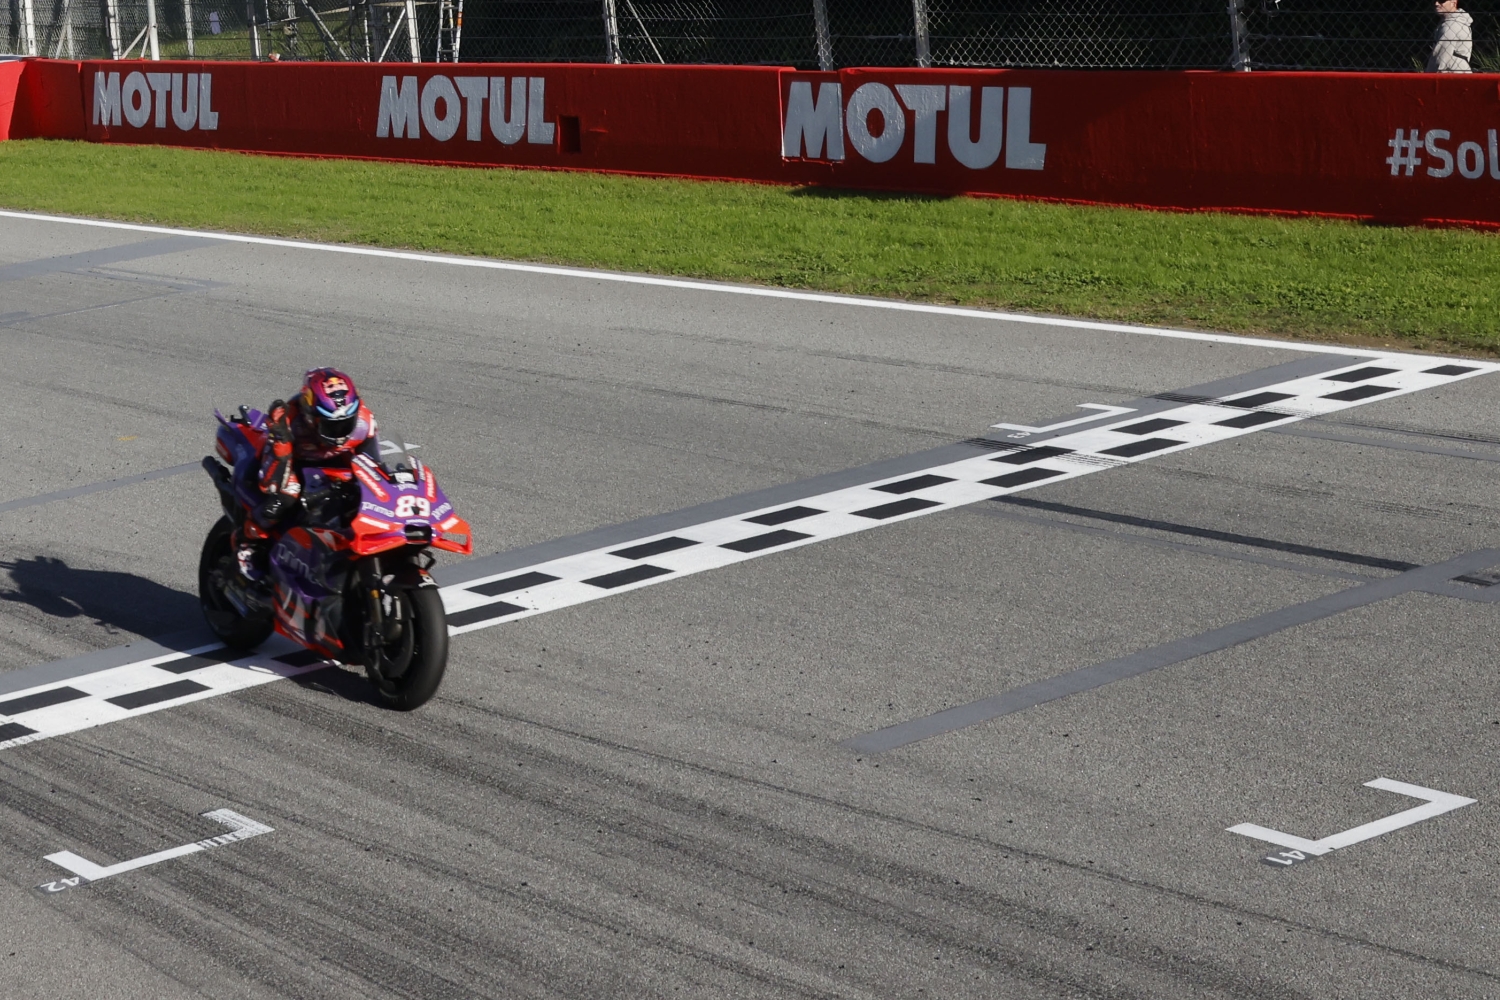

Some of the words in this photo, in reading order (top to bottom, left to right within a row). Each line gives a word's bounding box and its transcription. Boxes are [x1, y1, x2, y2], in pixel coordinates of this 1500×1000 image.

[93, 70, 219, 131] MOTUL
[376, 74, 555, 145] MOTUL
[782, 81, 1047, 171] MOTUL
[361, 501, 395, 518] prima
[394, 494, 431, 518] 89
[1266, 850, 1306, 865] 41
[40, 876, 79, 892] 42
